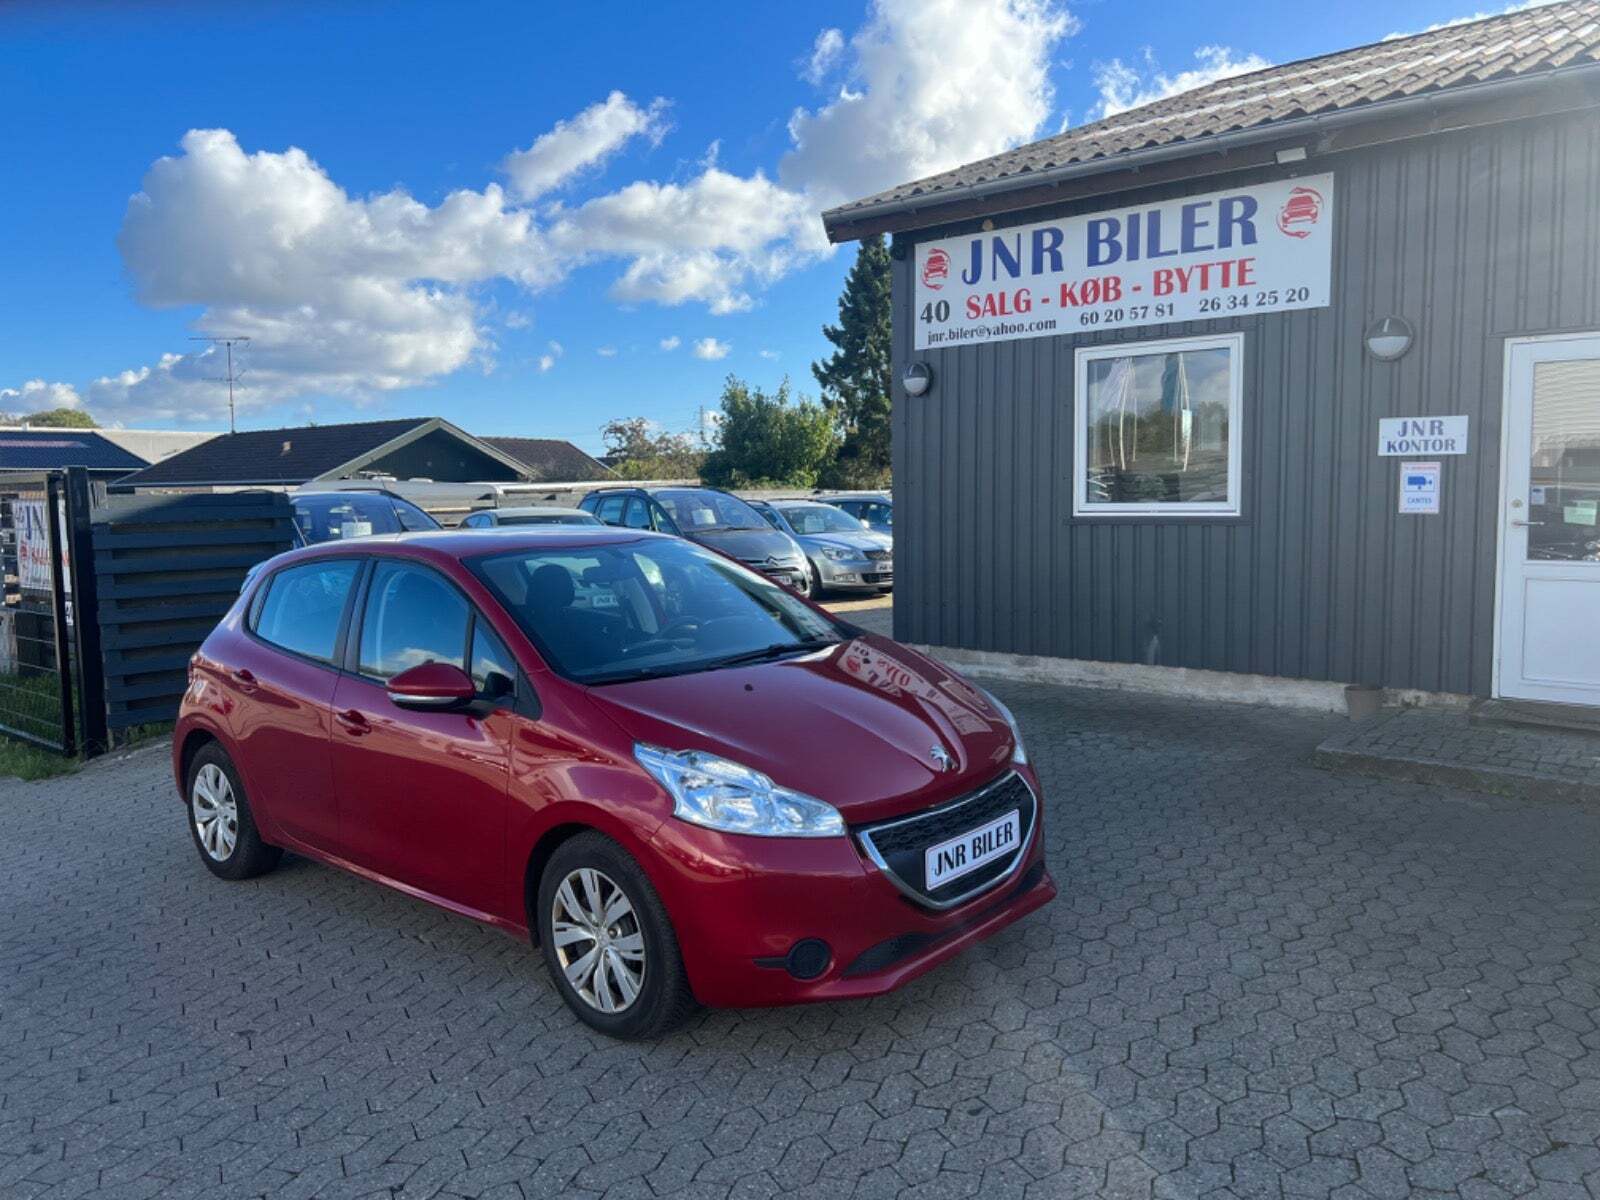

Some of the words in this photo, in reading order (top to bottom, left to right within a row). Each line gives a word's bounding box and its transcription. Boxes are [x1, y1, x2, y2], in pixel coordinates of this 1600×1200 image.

[962, 227, 1064, 285] JNR
[1087, 195, 1258, 268] BILER
[920, 300, 950, 324] 40
[928, 319, 1056, 345] jnr.biler@yahoo.com
[1080, 312, 1099, 326] 60
[1104, 308, 1124, 323] 20
[1129, 305, 1149, 320] 57
[1155, 303, 1174, 317] 81
[1199, 297, 1221, 313] 26
[1227, 294, 1249, 310] 34
[1256, 290, 1279, 307] 25
[1285, 287, 1309, 304] 20
[966, 288, 1031, 320] SALG
[1060, 276, 1122, 308] KØB
[1153, 258, 1256, 296] BYTTE
[1387, 438, 1456, 453] KONTOR
[1397, 420, 1444, 437] JNR
[934, 844, 966, 876] JNR
[972, 821, 1014, 860] BILER
